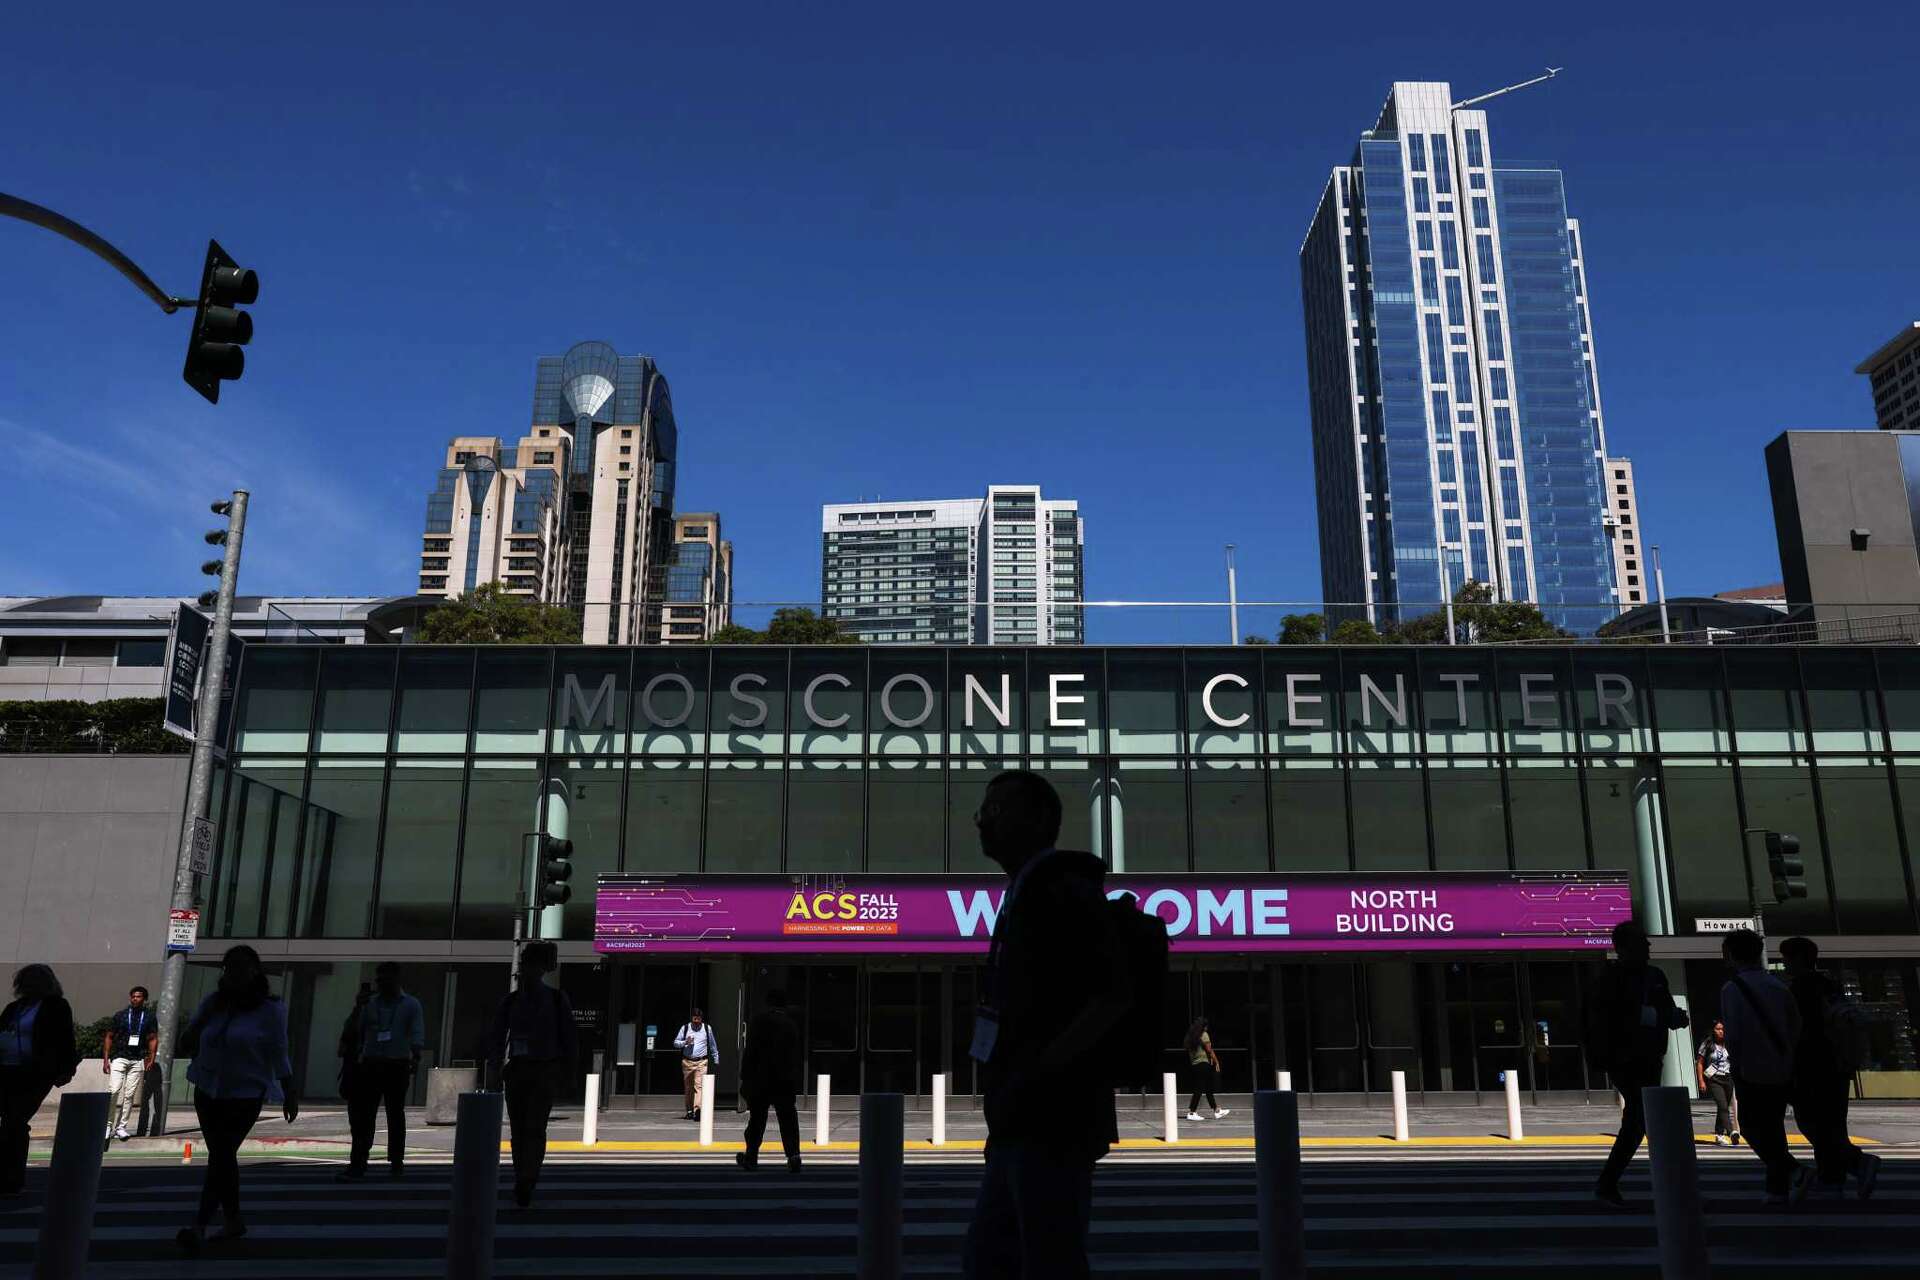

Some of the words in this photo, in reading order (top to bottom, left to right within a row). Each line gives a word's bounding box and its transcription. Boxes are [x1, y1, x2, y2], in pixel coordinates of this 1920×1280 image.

[560, 673, 1087, 727] MOSCONE
[1202, 673, 1638, 727] CENTER
[786, 893, 858, 920] ACS
[860, 894, 898, 906] FALL
[1350, 890, 1437, 909] NORTH
[859, 907, 898, 920] 2023
[947, 889, 1290, 937] WOME
[1336, 913, 1455, 932] BUILDING
[1703, 921, 1747, 929] Howard
